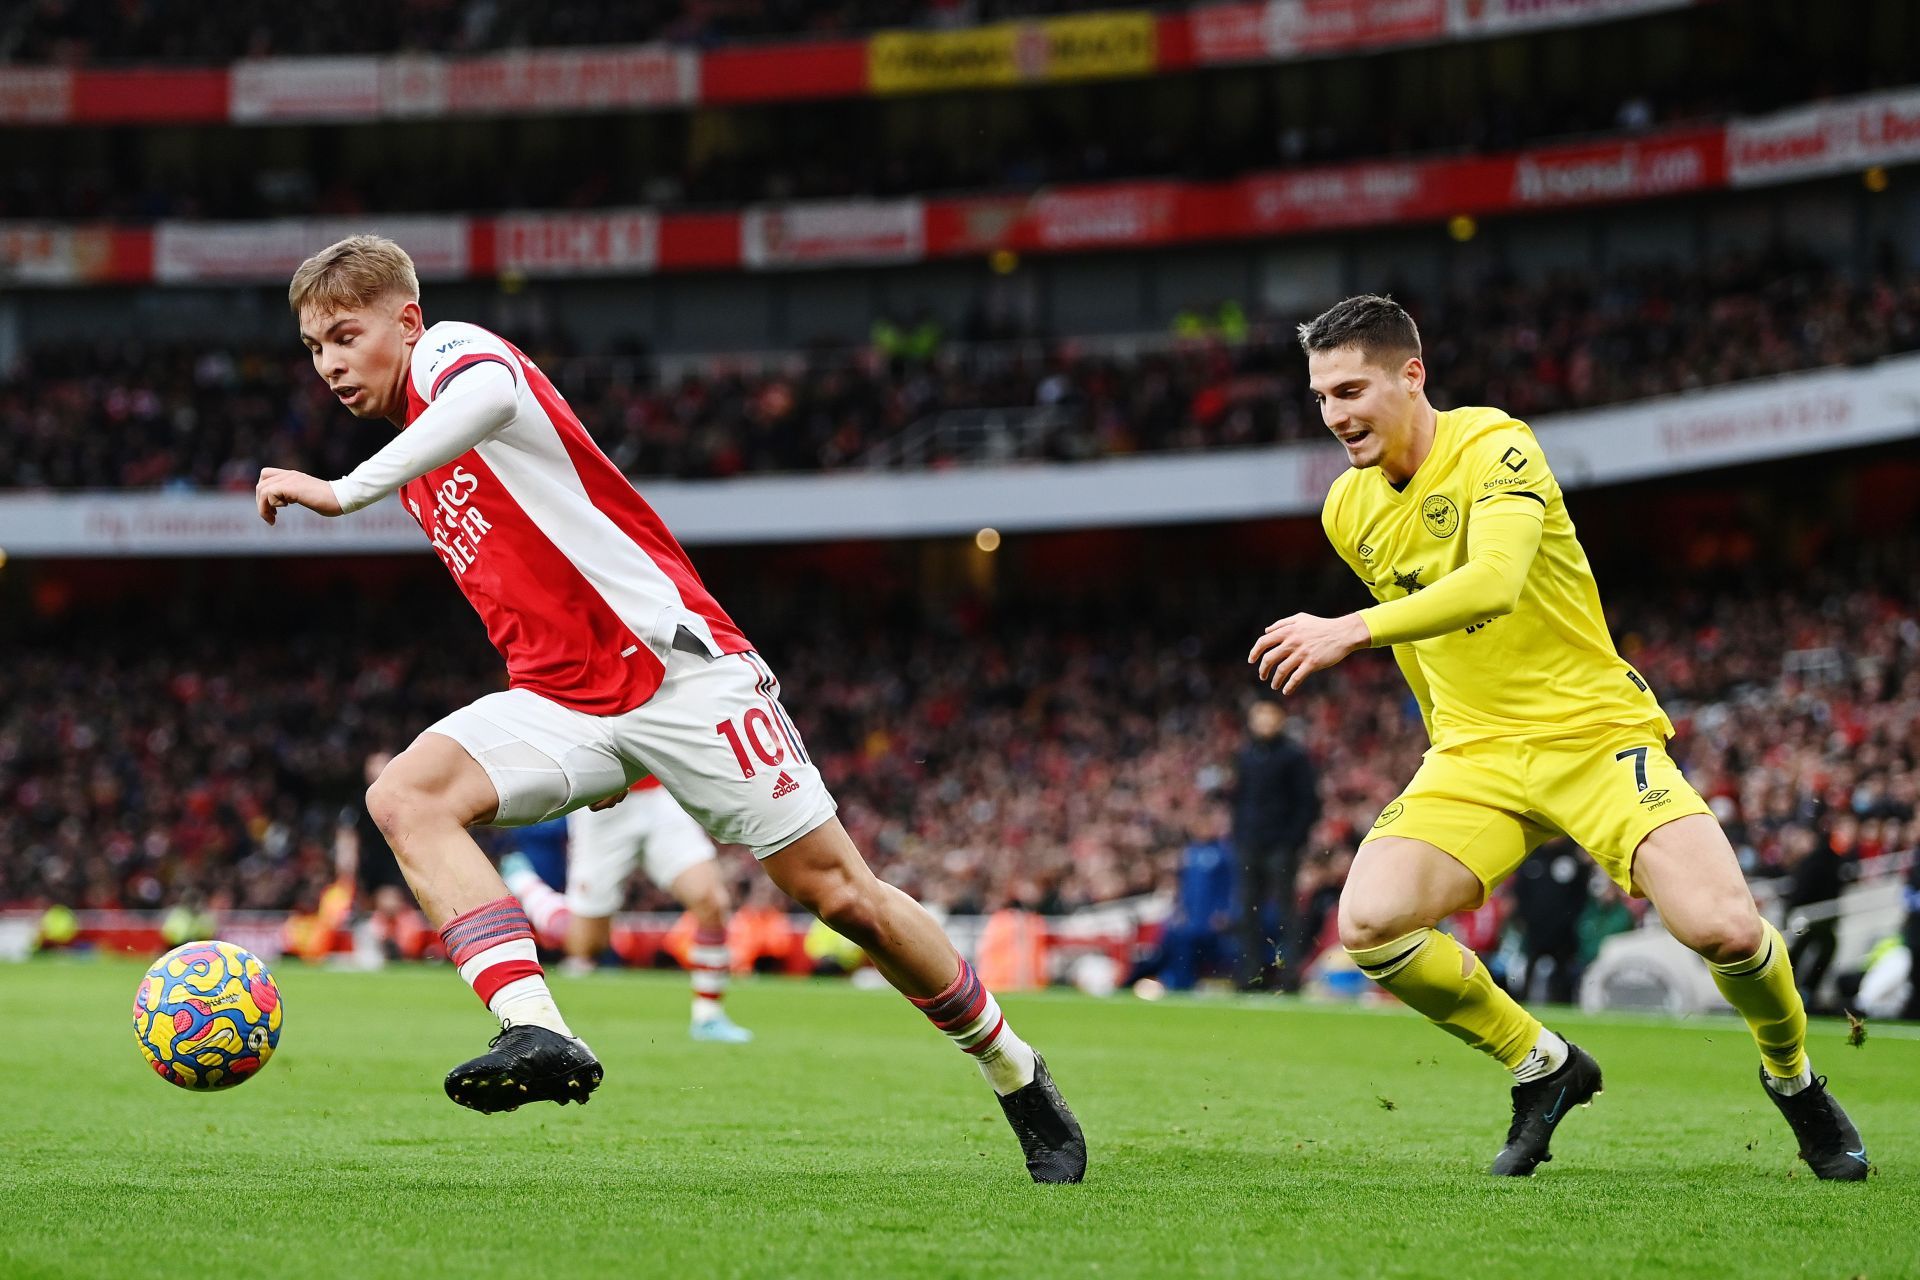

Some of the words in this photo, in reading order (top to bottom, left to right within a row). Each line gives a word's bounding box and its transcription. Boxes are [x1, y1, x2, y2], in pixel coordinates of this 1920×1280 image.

[715, 707, 785, 780] 10
[1615, 746, 1649, 793] 7
[772, 781, 800, 800] adidas
[1647, 798, 1672, 812] umbro
